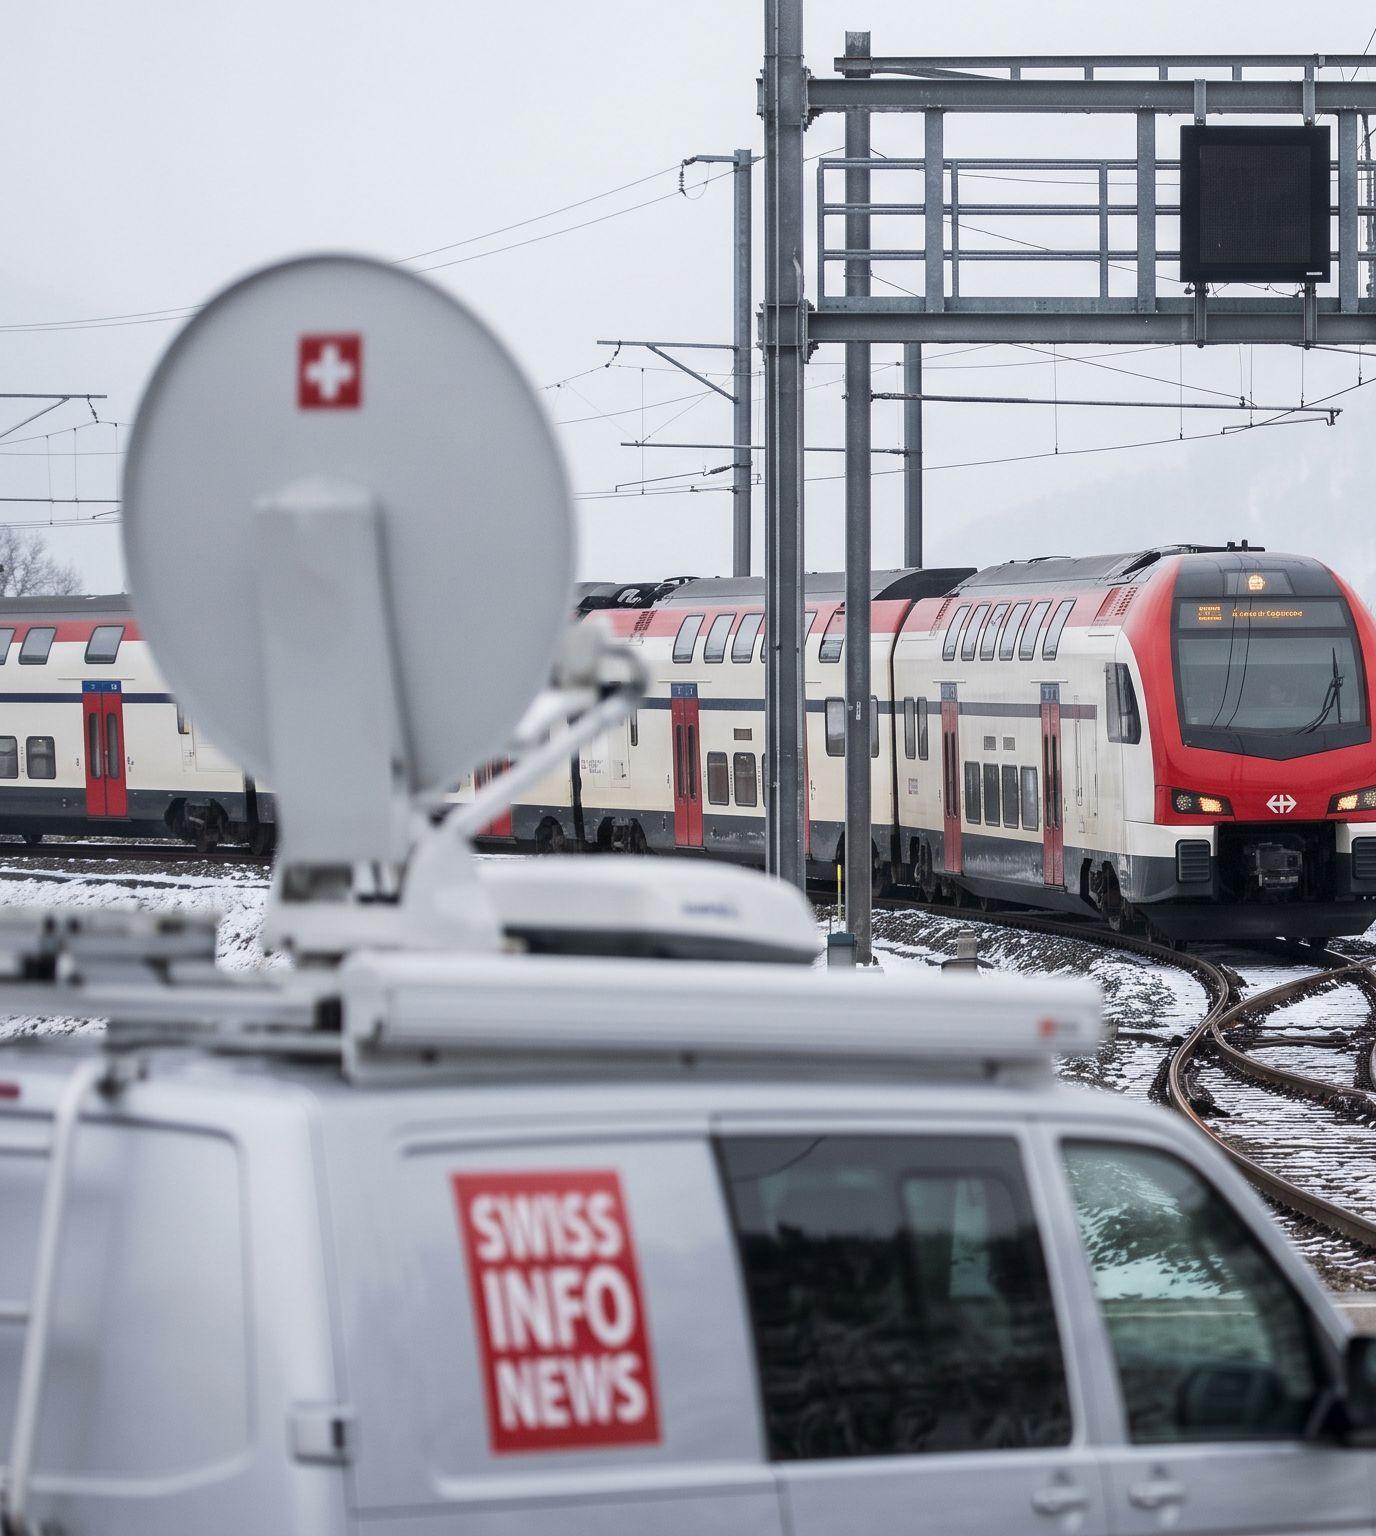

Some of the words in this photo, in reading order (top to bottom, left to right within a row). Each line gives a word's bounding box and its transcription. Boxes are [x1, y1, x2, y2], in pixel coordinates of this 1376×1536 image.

[470, 1192, 622, 1261] SWISS
[482, 1264, 637, 1350] INFO
[496, 1353, 648, 1430] NEWS
